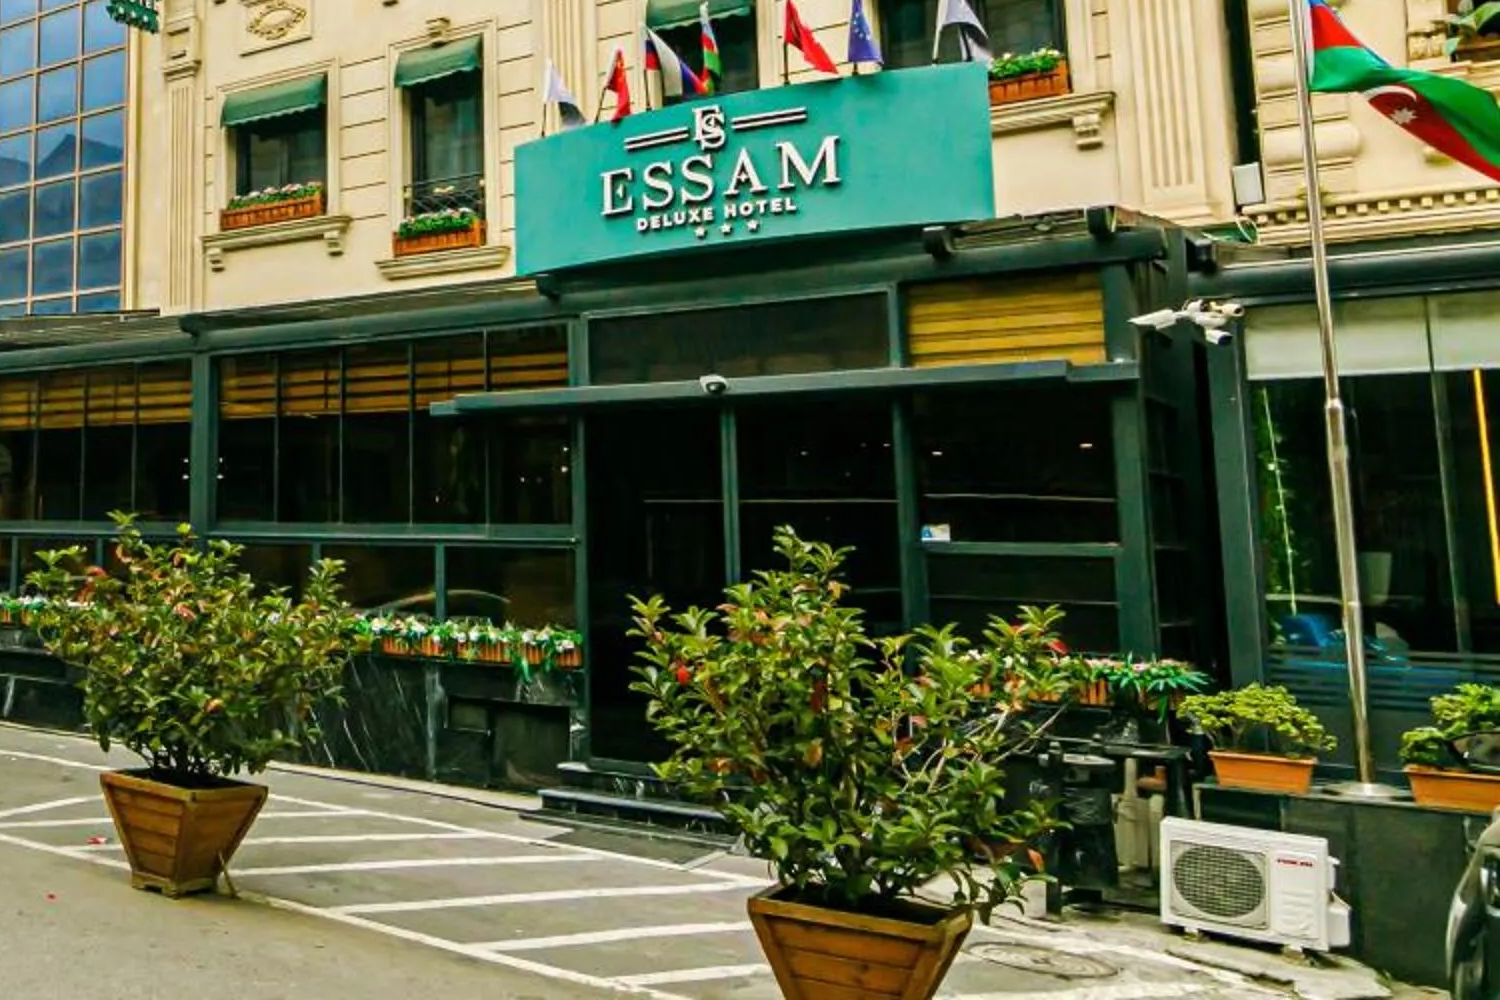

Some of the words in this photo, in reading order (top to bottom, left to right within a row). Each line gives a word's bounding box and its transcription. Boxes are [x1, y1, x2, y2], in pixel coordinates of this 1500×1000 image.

[599, 134, 842, 217] ESSAM
[636, 206, 715, 232] DELUXE
[724, 196, 798, 219] HOTEL
